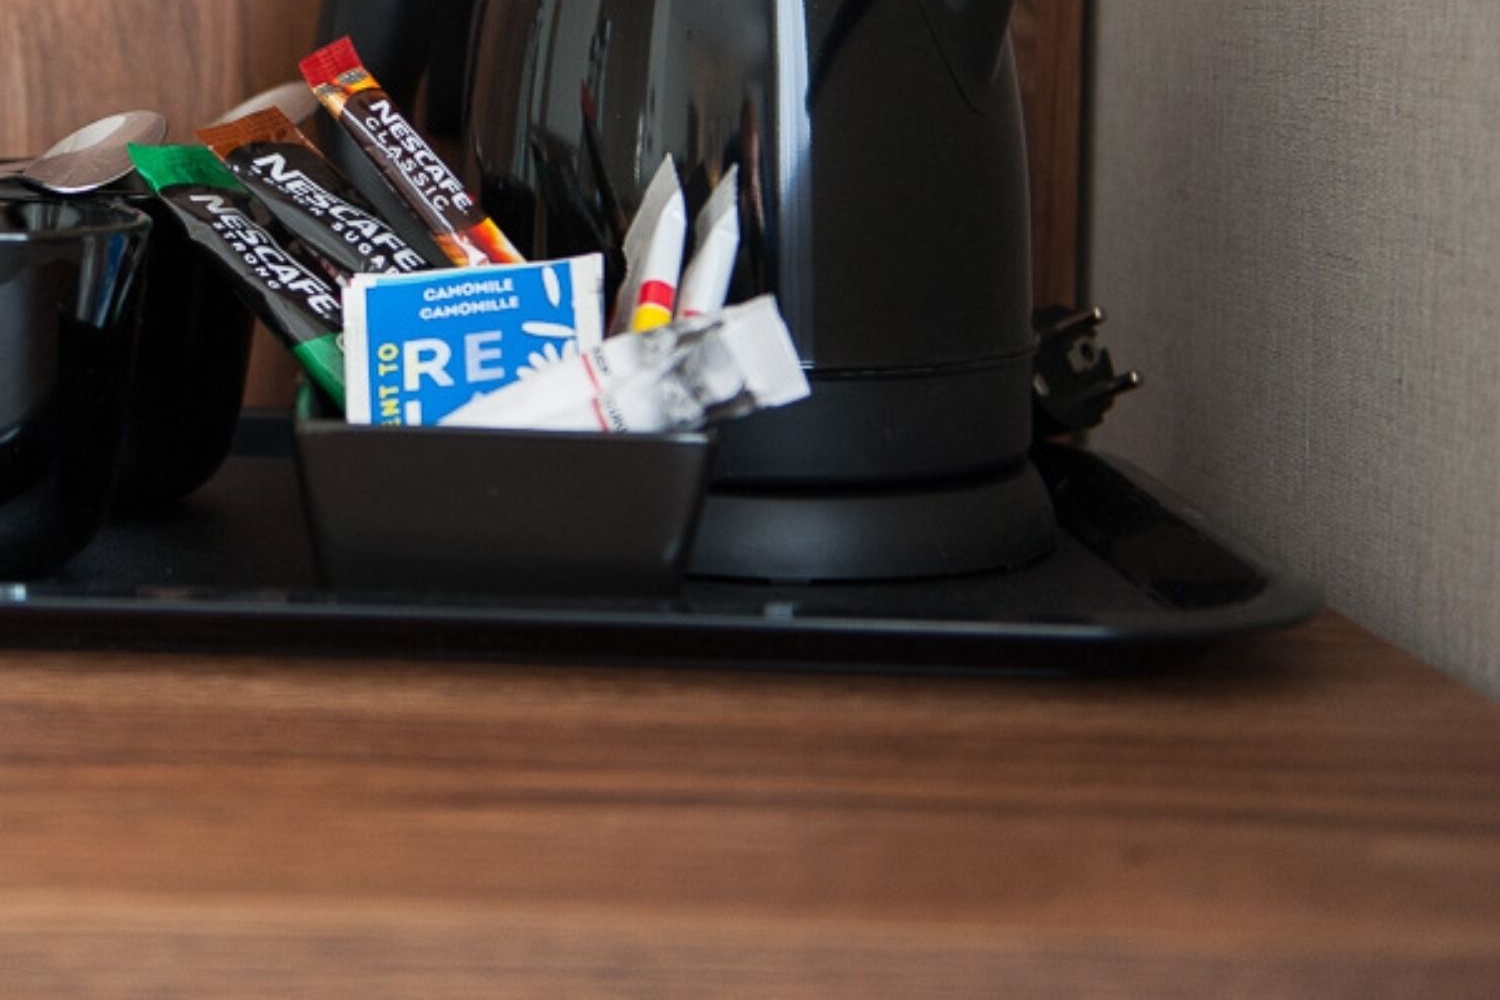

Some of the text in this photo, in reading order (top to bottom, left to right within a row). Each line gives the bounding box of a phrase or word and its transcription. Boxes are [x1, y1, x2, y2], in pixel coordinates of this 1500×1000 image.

[365, 117, 450, 211] CLASSIC
[212, 221, 282, 289] STRONG
[422, 277, 513, 302] CAMOMILE
[418, 295, 520, 320] CAMOMILLE
[377, 342, 400, 377] TO
